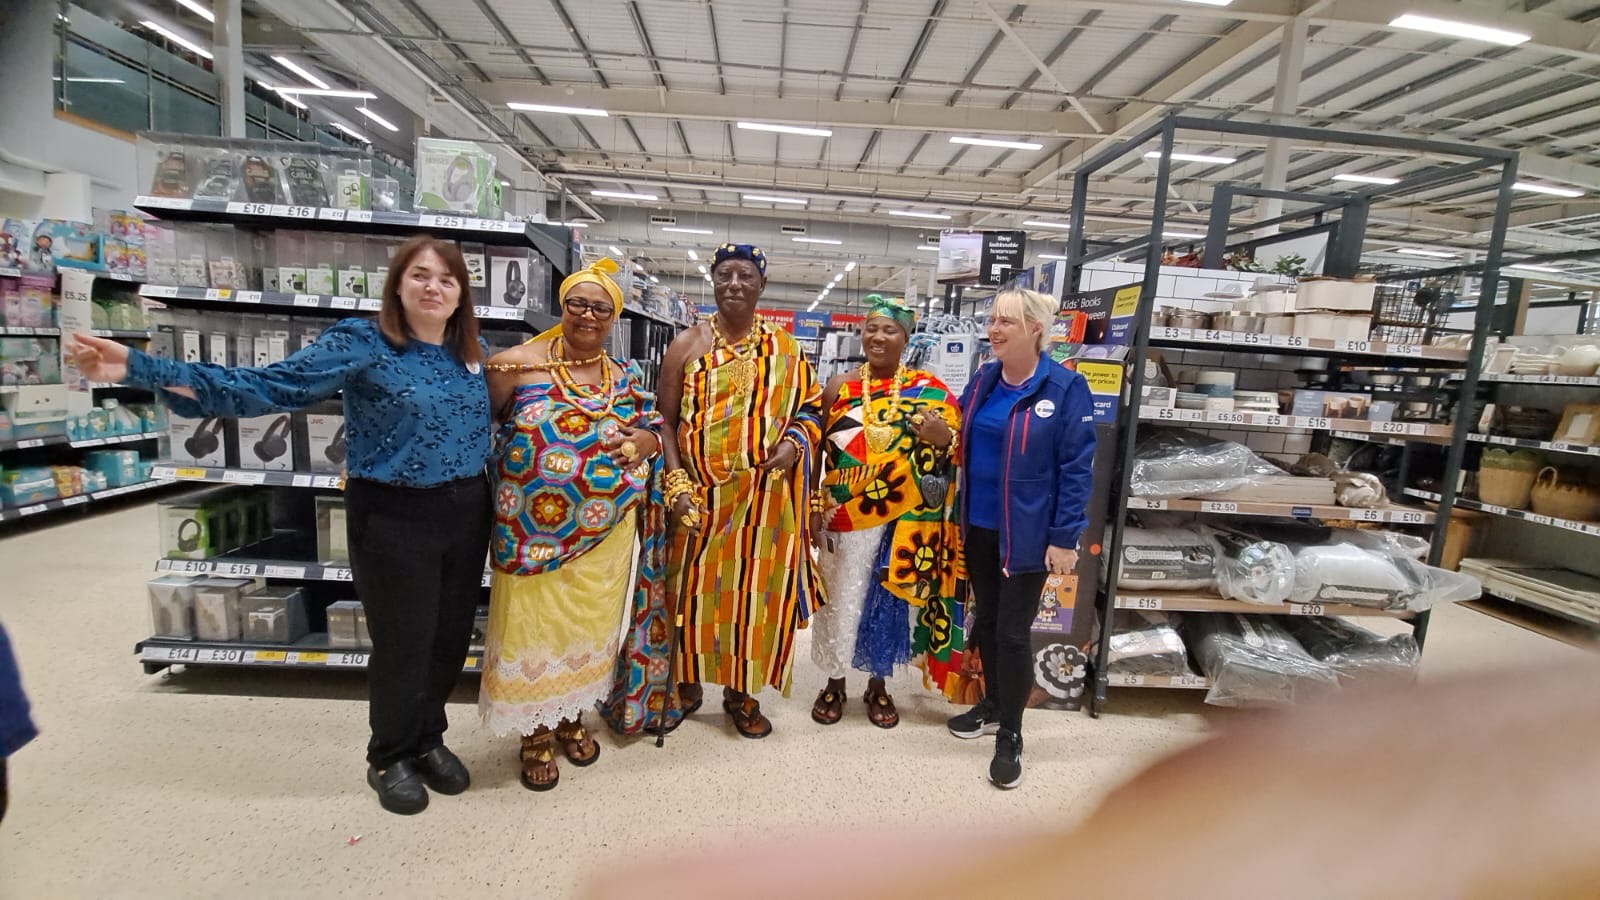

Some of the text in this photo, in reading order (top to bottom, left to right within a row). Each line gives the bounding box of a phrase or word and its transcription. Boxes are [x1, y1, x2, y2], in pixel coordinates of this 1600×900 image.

[243, 203, 265, 214] £16
[288, 206, 309, 217] £16
[435, 216, 458, 227] £25
[480, 220, 503, 229] £25
[64, 291, 87, 302] £5.25
[1062, 297, 1102, 310] Kids' Books
[474, 306, 490, 317] 32
[1164, 327, 1179, 338] £3
[1205, 330, 1220, 340] £4
[1244, 333, 1258, 343] £5
[1287, 336, 1302, 346] £6
[1347, 341, 1367, 352] £10
[1396, 345, 1411, 354] £15
[1159, 408, 1173, 418] £5
[1218, 412, 1242, 422] £5.50
[1267, 415, 1280, 425] £5
[1308, 418, 1326, 428] £16
[1383, 423, 1403, 433] £20
[1146, 501, 1161, 509] £3
[1211, 503, 1235, 512] £2.50
[1364, 510, 1377, 520] £6
[1403, 513, 1421, 522] £10
[186, 563, 207, 572] £10
[230, 564, 250, 574] £15
[1138, 598, 1156, 608] £15
[1301, 604, 1321, 615] £20
[168, 648, 190, 659] £14
[211, 650, 237, 661] £30
[341, 654, 364, 664] £10
[1124, 676, 1137, 684] £5
